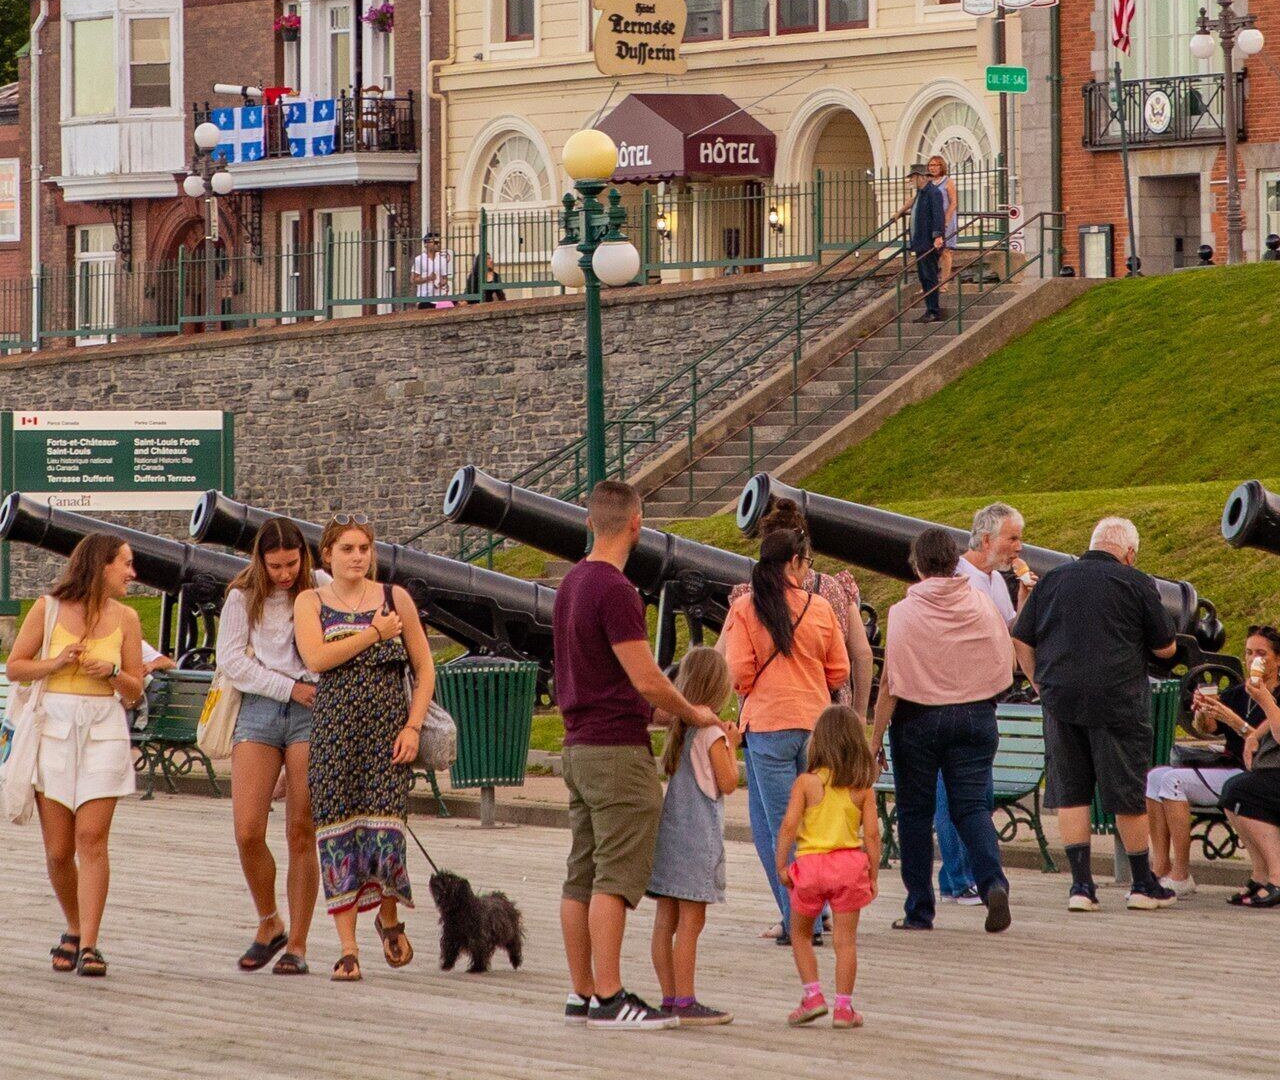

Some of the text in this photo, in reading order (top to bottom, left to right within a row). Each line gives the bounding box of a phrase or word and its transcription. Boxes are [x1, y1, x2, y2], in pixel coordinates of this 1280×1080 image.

[608, 13, 676, 35] Terrasse
[615, 40, 676, 66] Dufferin
[987, 73, 1026, 85] CUL-DE-SAC
[699, 136, 760, 165] HÔTEL
[133, 437, 200, 446] Saint-Louis Forts
[46, 447, 91, 455] Saint-Louis
[133, 447, 149, 455] and
[47, 474, 114, 483] Terrasse Dufferin
[133, 474, 197, 483] Dufferin Terrace
[47, 494, 91, 507] Canada
